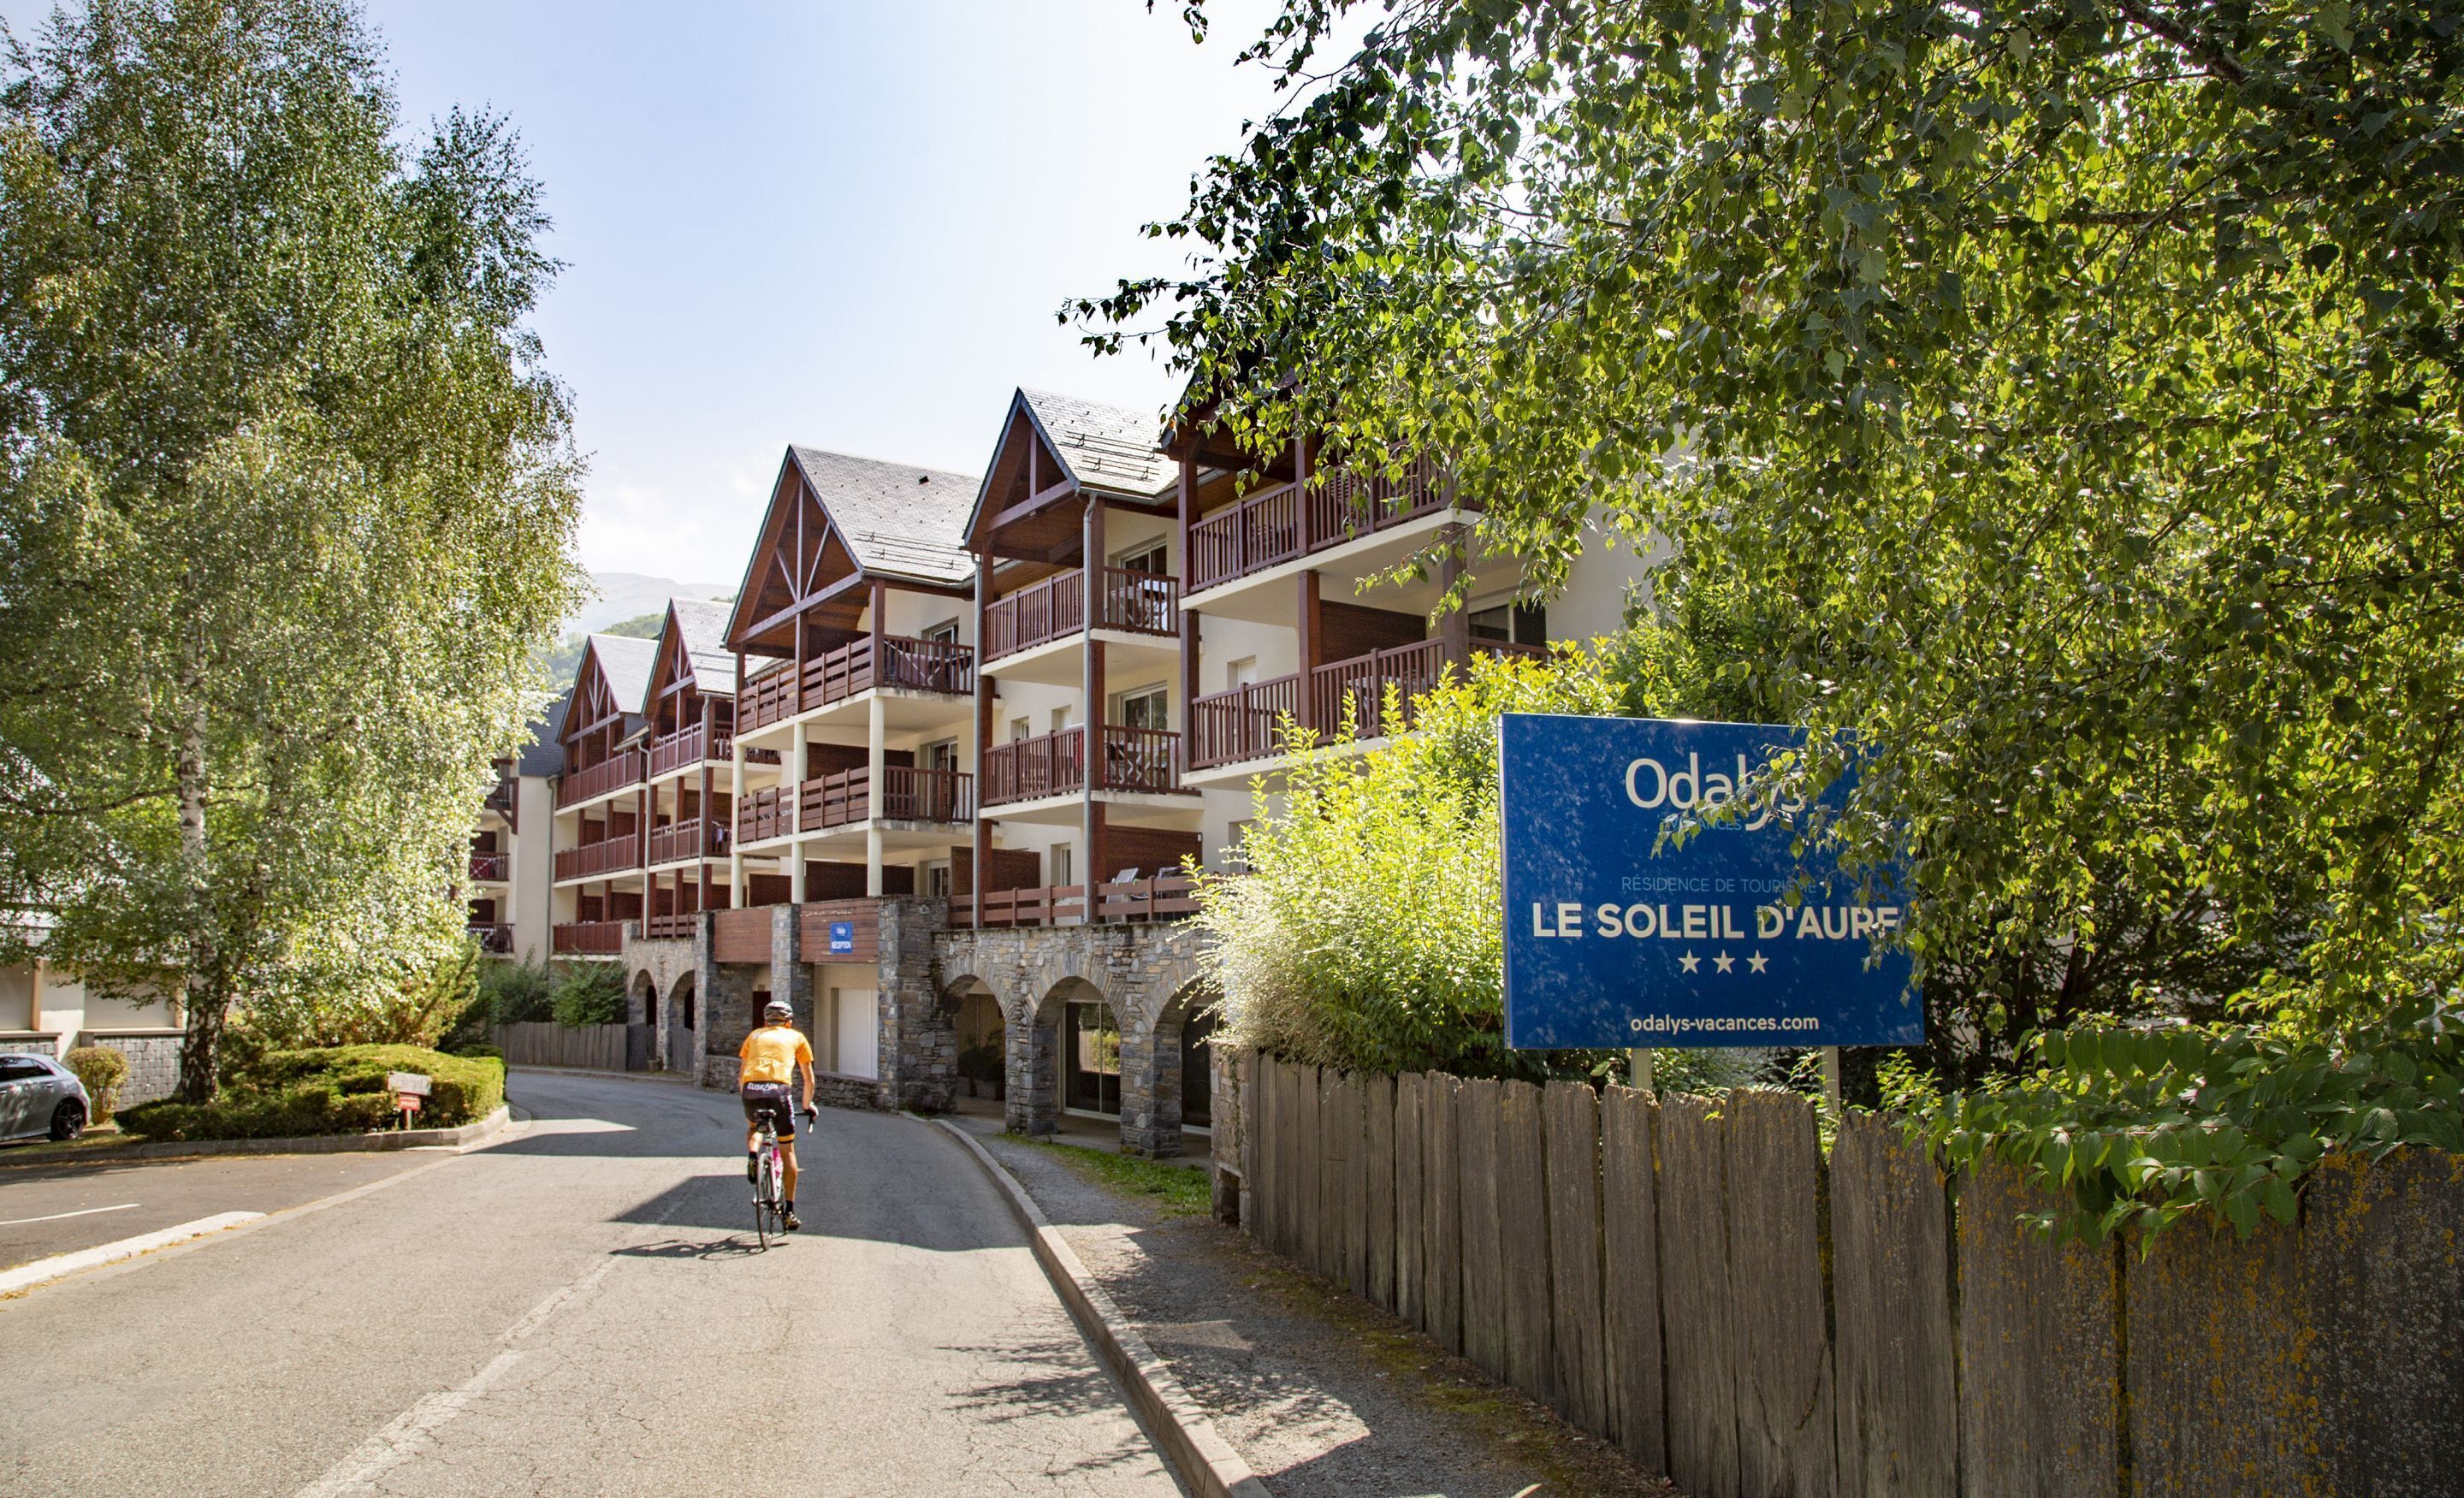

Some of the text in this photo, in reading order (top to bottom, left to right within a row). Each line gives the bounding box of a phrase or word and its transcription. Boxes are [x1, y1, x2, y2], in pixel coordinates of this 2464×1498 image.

[1621, 874, 1709, 892] RÉSIDENCE
[1715, 879, 1735, 892] DE
[1532, 903, 1898, 939] LE SOLEIL D'AURE
[1631, 1014, 1820, 1035] odalys-vacances.com
